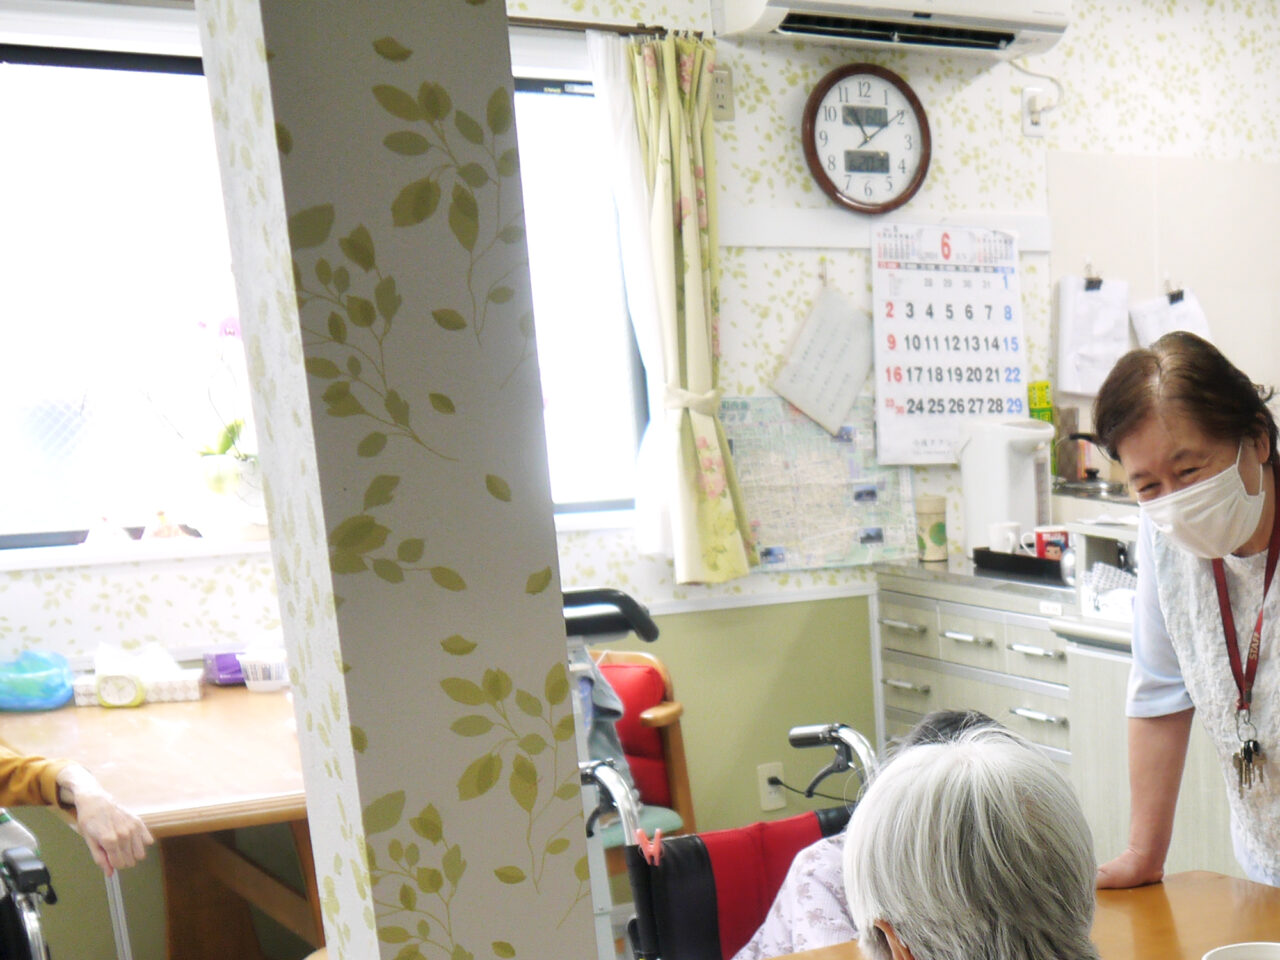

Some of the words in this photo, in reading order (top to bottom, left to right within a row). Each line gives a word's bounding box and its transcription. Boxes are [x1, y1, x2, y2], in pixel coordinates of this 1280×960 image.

[839, 86, 849, 103] 11
[857, 81, 871, 98] 12
[823, 105, 837, 122] 10
[820, 131, 828, 147] 9
[905, 134, 912, 150] 3
[828, 155, 836, 171] 8
[898, 159, 906, 174] 4
[844, 174, 852, 190] 7
[864, 180, 873, 196] 6
[886, 176, 893, 191] 5
[941, 232, 952, 260] 6
[886, 301, 894, 318] 2
[906, 302, 914, 319] 3
[926, 303, 934, 319] 4
[946, 304, 954, 319] 5
[965, 305, 973, 320] 6
[985, 305, 993, 320] 7
[1005, 305, 1012, 321] 8
[887, 334, 896, 350] 9
[904, 335, 921, 350] 10
[925, 336, 939, 351] 11
[944, 336, 960, 351] 12
[964, 336, 980, 351] 13
[984, 336, 999, 351] 14
[1003, 336, 1018, 351] 15
[886, 367, 902, 382] 16
[907, 367, 923, 382] 17
[927, 367, 943, 382] 18
[947, 367, 963, 382] 19
[966, 367, 982, 382] 20
[986, 367, 1000, 382] 21
[1005, 367, 1021, 383] 22
[907, 398, 924, 414] 24
[928, 398, 945, 414] 25
[948, 398, 965, 414] 26
[968, 398, 983, 414] 27
[987, 398, 1003, 413] 28
[1007, 398, 1023, 414] 29
